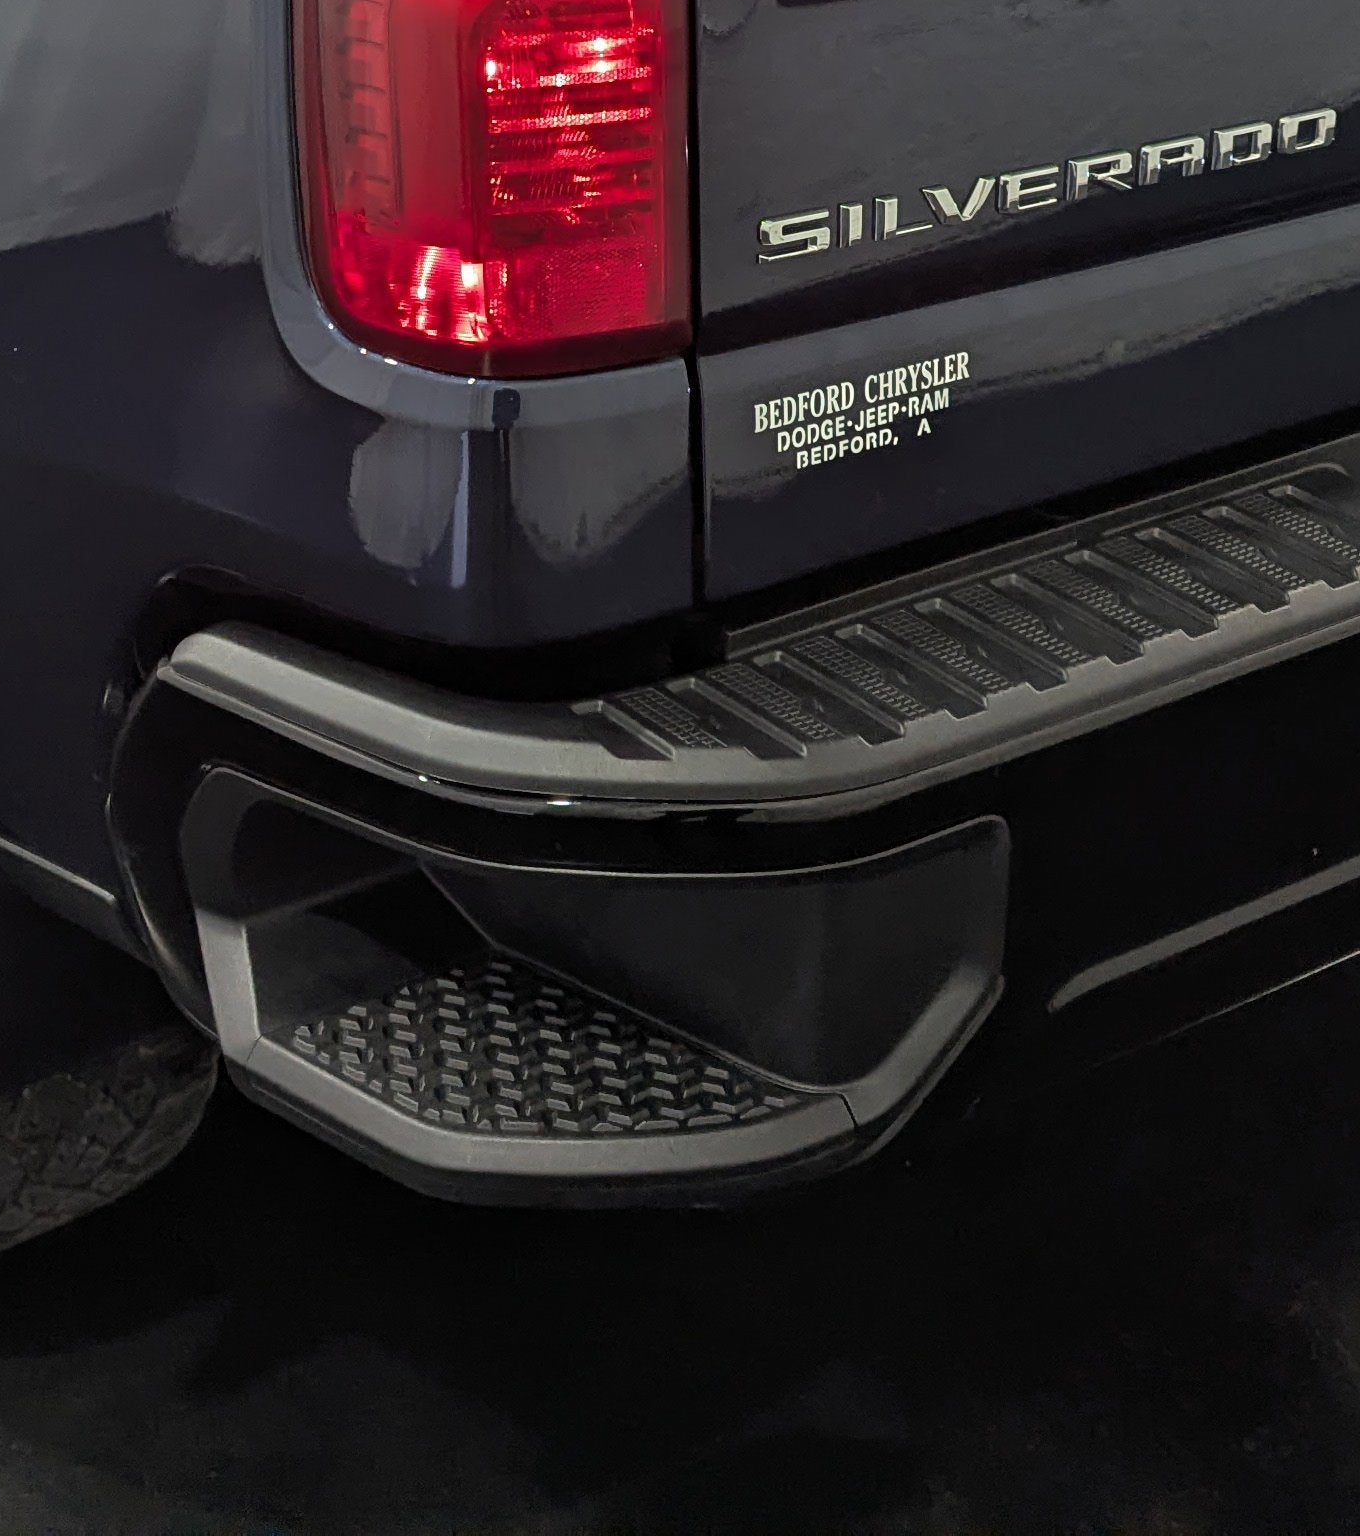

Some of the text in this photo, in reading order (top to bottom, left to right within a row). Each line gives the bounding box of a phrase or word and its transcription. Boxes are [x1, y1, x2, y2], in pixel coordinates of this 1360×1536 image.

[757, 107, 1338, 264] SILVERADO
[754, 352, 971, 434] BEDFORD CHRYSLER
[796, 428, 899, 470] BEDFORD,
